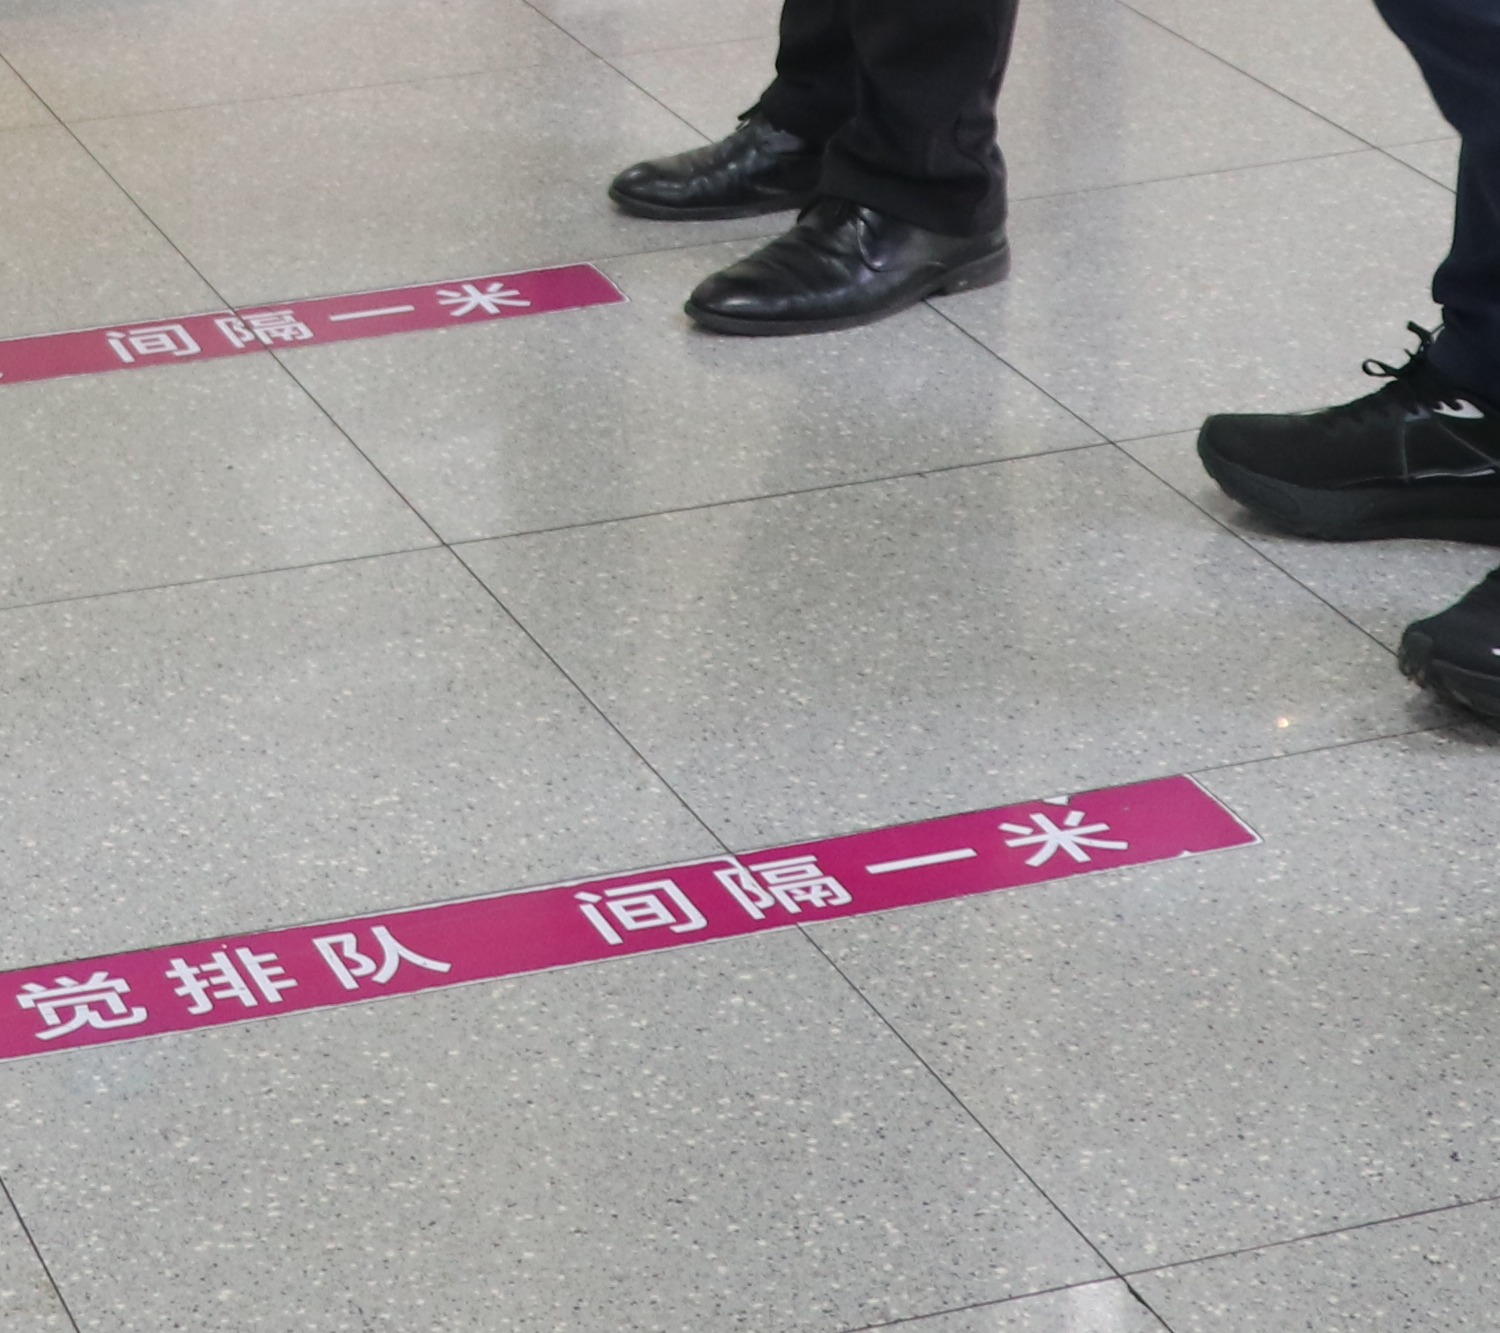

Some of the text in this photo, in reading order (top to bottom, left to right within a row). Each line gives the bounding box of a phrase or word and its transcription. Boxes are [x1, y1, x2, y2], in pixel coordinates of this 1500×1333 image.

[106, 282, 532, 364] 间隔一米
[574, 810, 1129, 946] 间隔一米
